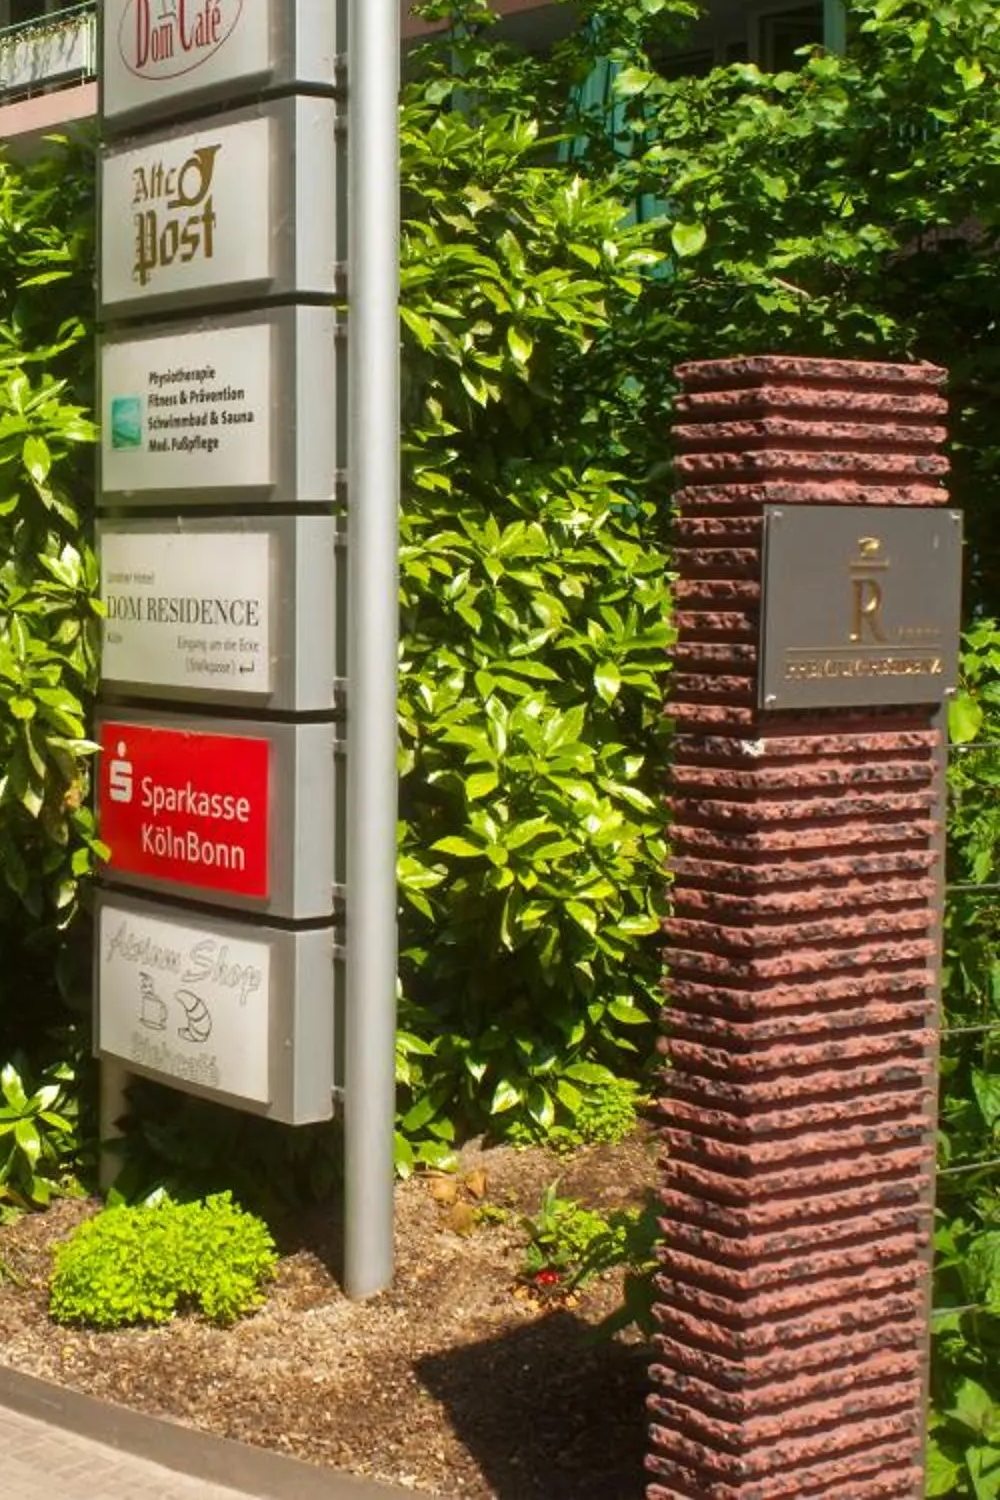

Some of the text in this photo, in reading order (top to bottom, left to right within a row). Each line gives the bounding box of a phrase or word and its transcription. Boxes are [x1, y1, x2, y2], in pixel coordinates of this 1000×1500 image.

[132, 195, 216, 287] Post
[148, 385, 245, 407] Fitness & Prävention
[149, 365, 217, 388] Physiotherapie
[148, 409, 255, 430] Schwimmbad & Sauna
[106, 595, 259, 627] DOM RESIDENCE
[141, 776, 250, 822] Sparkasse
[141, 823, 245, 871] KölnBonn
[181, 939, 262, 1006] Shop
